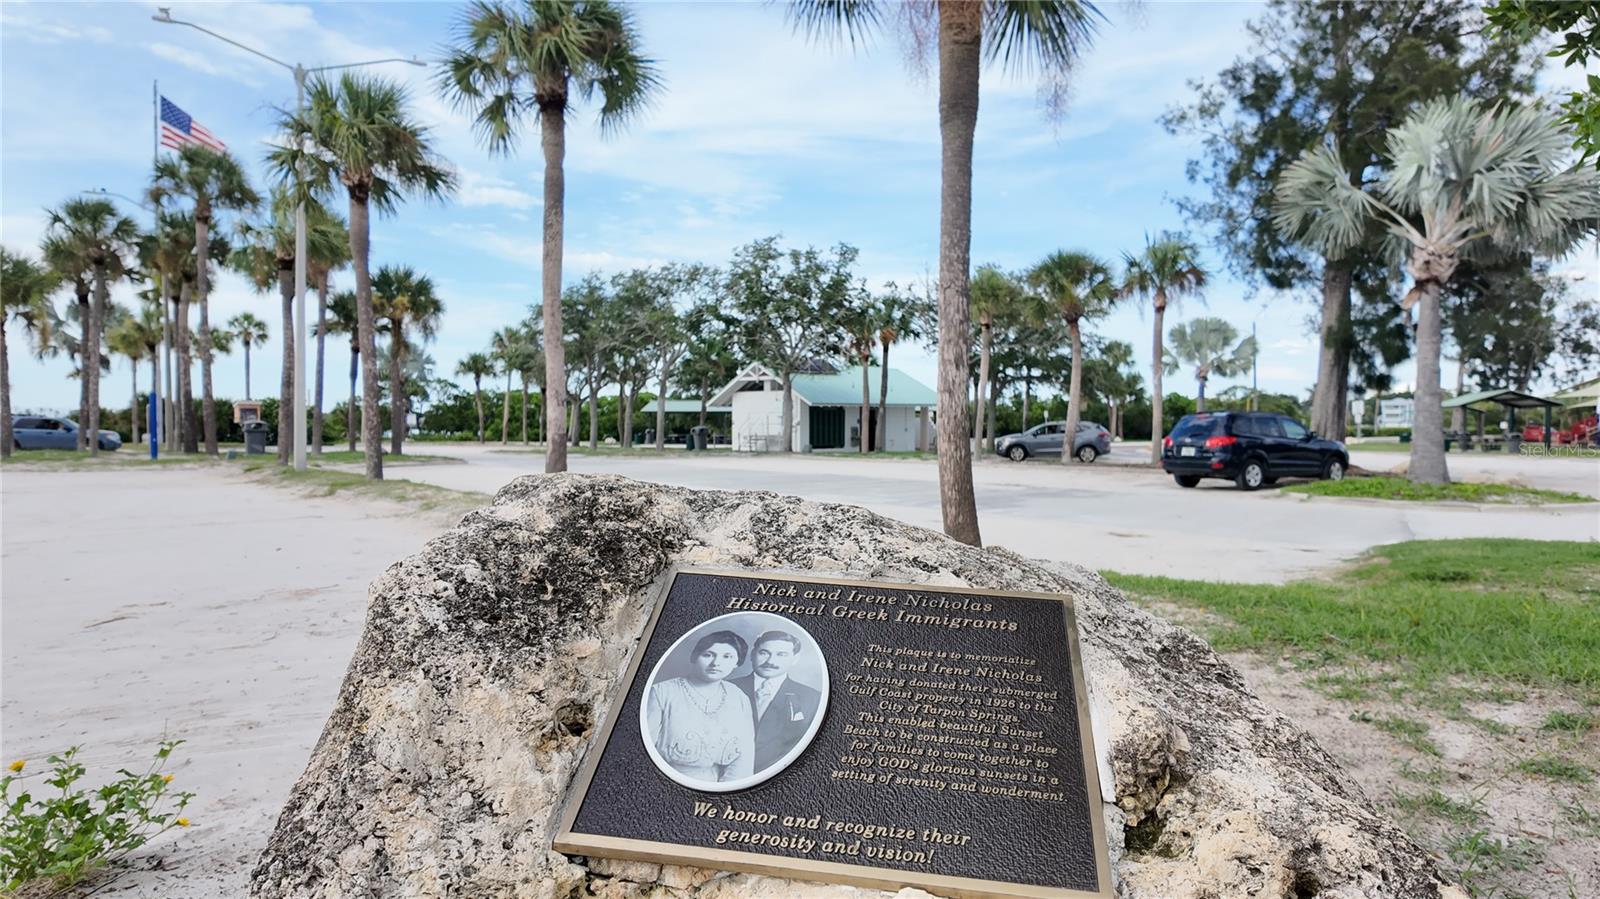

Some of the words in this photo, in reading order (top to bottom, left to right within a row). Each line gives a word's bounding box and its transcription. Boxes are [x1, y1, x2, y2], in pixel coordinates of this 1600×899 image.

[753, 583, 797, 598] Nick
[803, 588, 840, 601] and
[847, 592, 897, 605] Irene
[904, 595, 993, 612] Nicholas
[726, 598, 824, 616] Historical
[832, 607, 888, 621] Greek
[895, 610, 1018, 631] Immigrants
[868, 644, 892, 654] This
[895, 647, 933, 658] plaque
[951, 651, 961, 659] to
[965, 653, 1036, 665] memorialize
[861, 658, 894, 669] Nick
[899, 661, 927, 672] and
[931, 664, 970, 676] Irene
[975, 668, 1042, 682] Nicholas
[845, 673, 862, 682] for
[866, 674, 905, 686] having
[909, 678, 956, 690] donated
[960, 682, 989, 693] their
[993, 686, 1058, 701] submerged
[849, 685, 876, 696] Gulf
[879, 688, 912, 699] Coast
[915, 691, 965, 704] property
[970, 696, 981, 704] in
[987, 698, 1015, 708] 1926
[1019, 701, 1031, 710] to
[1035, 701, 1054, 712] the
[858, 712, 884, 722] This
[888, 716, 935, 729] enabled
[939, 720, 996, 734] beautiful
[1001, 726, 1043, 738] Sunset
[879, 701, 903, 712] City
[907, 704, 921, 714] of
[923, 705, 965, 718] Tarpon
[969, 709, 1021, 723] Springs.
[843, 725, 880, 737] Beach
[884, 729, 896, 738] to
[900, 729, 913, 740] be
[917, 731, 989, 747] constructed
[993, 740, 1008, 749] as
[1024, 744, 1058, 755] place
[850, 740, 870, 750] for
[872, 741, 923, 755] families
[927, 747, 940, 757] to
[944, 751, 975, 760] come
[979, 753, 1032, 768] together
[1036, 759, 1049, 769] to
[841, 755, 875, 767] enjoy
[878, 757, 918, 770] GOD's
[921, 763, 975, 776] glorious
[979, 767, 1028, 782] sunsets
[1032, 774, 1046, 784] in
[1050, 777, 1059, 785] a
[831, 769, 876, 783] setting
[879, 773, 893, 784] of
[895, 776, 947, 790] serenity
[951, 781, 976, 792] and
[981, 784, 1067, 801] wonderment.
[693, 802, 717, 818] We
[722, 808, 778, 826] honor
[783, 815, 820, 830] and
[826, 820, 916, 839] recognize
[922, 828, 971, 846] their
[716, 828, 816, 852] generosity
[822, 840, 860, 854] and
[866, 846, 934, 864] vision!
